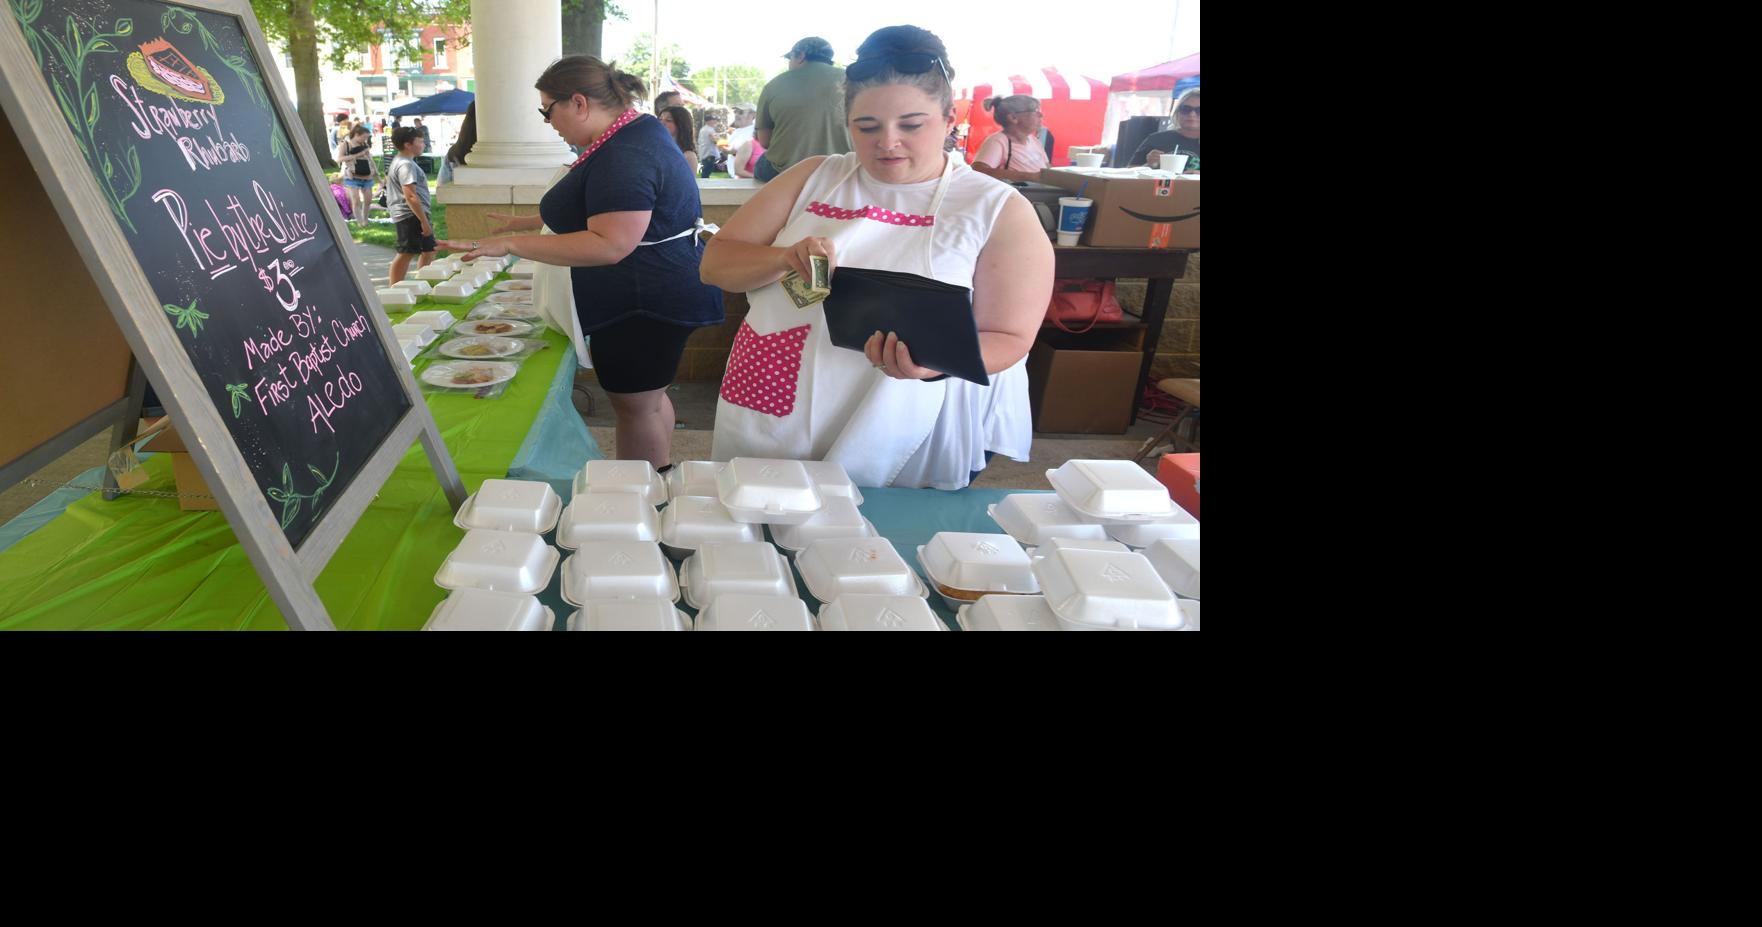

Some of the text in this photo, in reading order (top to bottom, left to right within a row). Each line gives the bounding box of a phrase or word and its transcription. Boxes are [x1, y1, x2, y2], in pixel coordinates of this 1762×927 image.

[152, 188, 227, 270] Pie
[205, 199, 257, 272] by
[252, 180, 318, 244] Slice
[243, 327, 293, 370] Made
[288, 334, 337, 385] Baptist
[331, 303, 371, 347] Church
